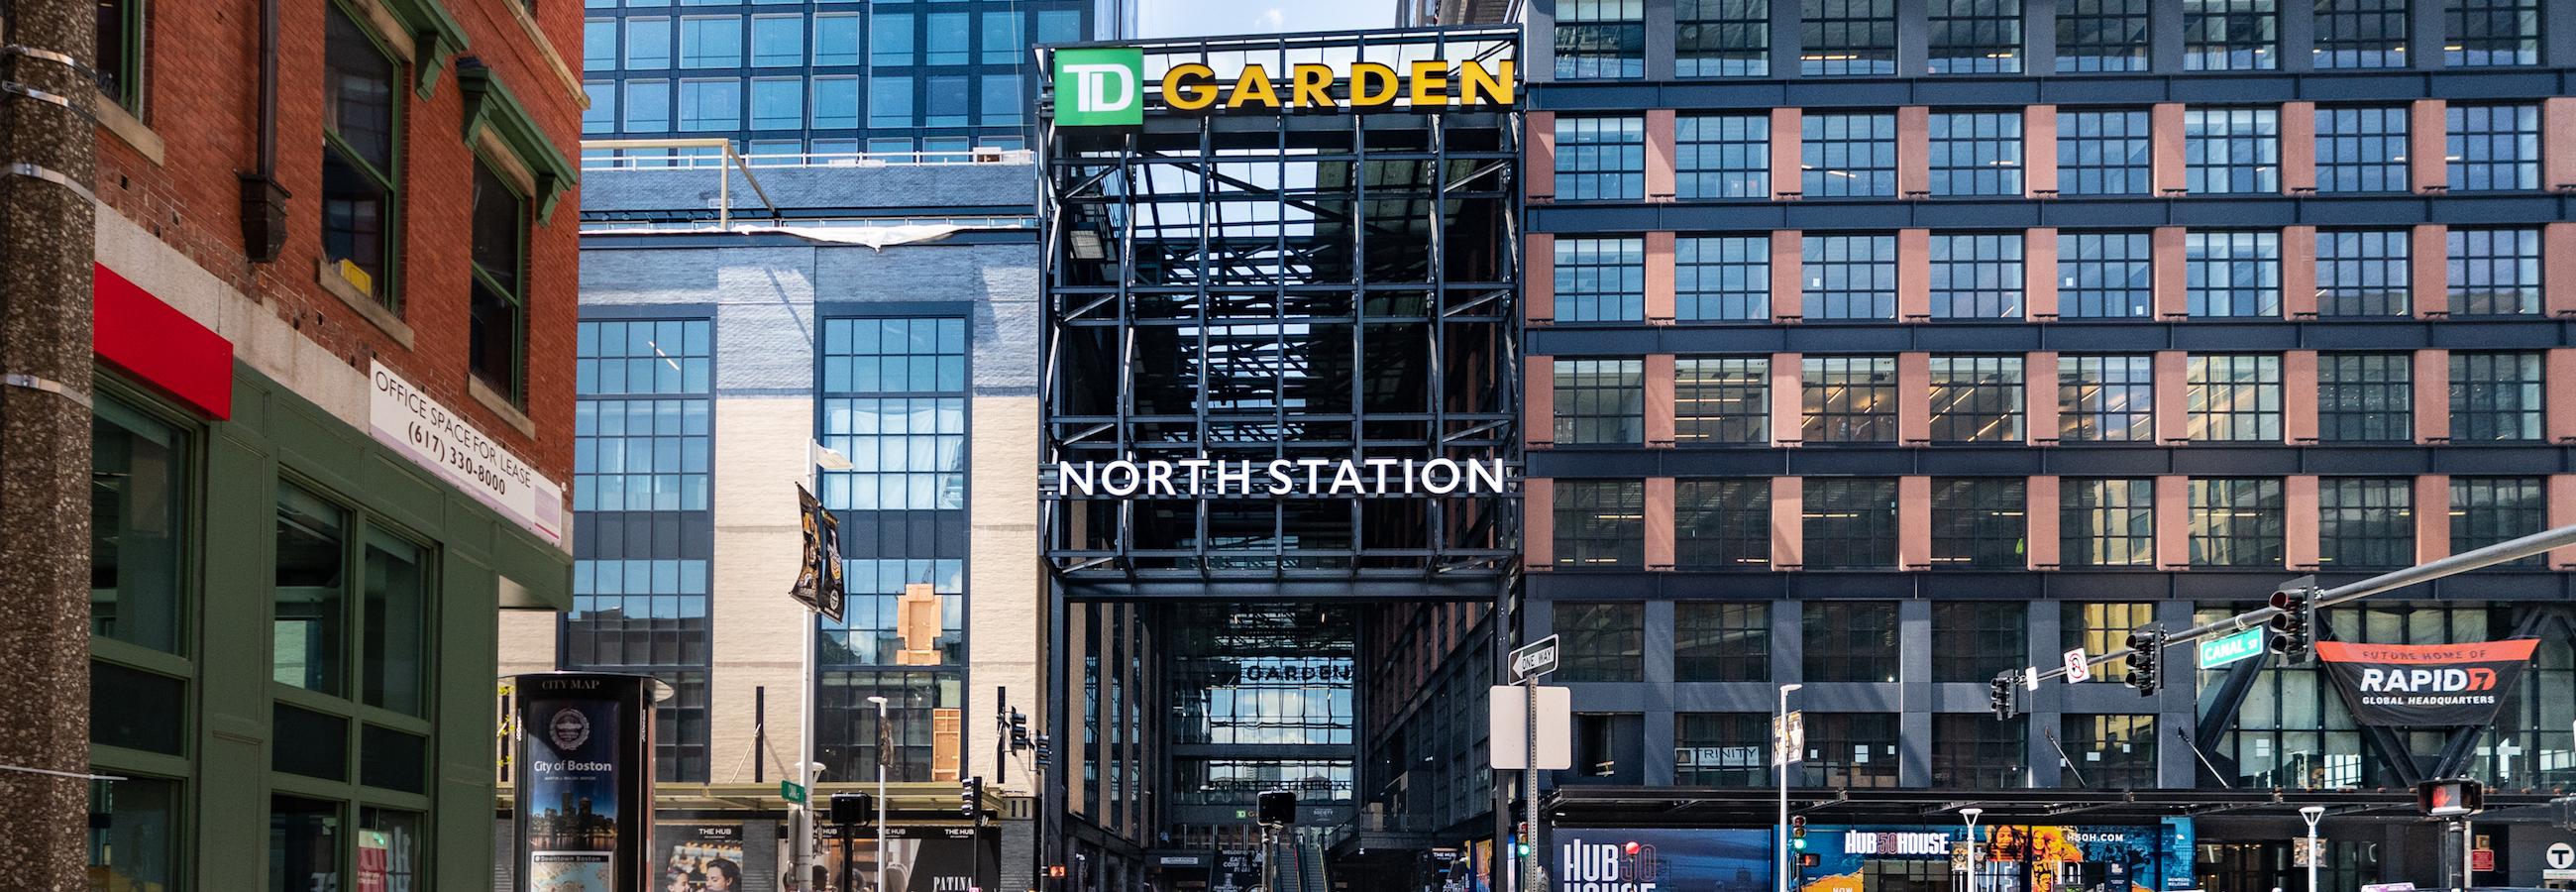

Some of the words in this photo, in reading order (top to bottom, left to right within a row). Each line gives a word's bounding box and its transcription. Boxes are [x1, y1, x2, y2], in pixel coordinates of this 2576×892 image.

[1062, 63, 1135, 113] TD
[1162, 59, 1515, 113] GARDEN
[376, 371, 427, 419] OFFICE
[431, 407, 471, 448] SPACE
[474, 436, 497, 467] FOR
[500, 454, 531, 489] LEASE
[408, 421, 446, 462] (617)
[450, 447, 506, 496] 330-8000
[1059, 459, 1250, 496] NORTH
[1268, 458, 1504, 495] STATION
[1522, 654, 1535, 670] ONE
[1538, 647, 1553, 664] WAY
[2204, 638, 2246, 661] CANAL
[2248, 639, 2258, 649] ST
[2363, 651, 2416, 660] FUTURE
[2422, 651, 2463, 660] HOME
[2470, 650, 2487, 659] OF
[542, 680, 570, 690] CITY
[571, 680, 600, 690] MAP
[2360, 667, 2497, 692] RAPID7
[2362, 696, 2404, 705] GLOBAL
[2408, 696, 2495, 705] HEADQUARTERS
[1693, 748, 1758, 759] TRINITY
[534, 760, 553, 774] City
[554, 760, 566, 772] of
[568, 760, 612, 772] Boston
[1845, 829, 1950, 854] HUB50HOUSE
[2067, 833, 2124, 841] H50H.COM
[2551, 849, 2570, 865] T
[933, 876, 973, 891] PATINA
